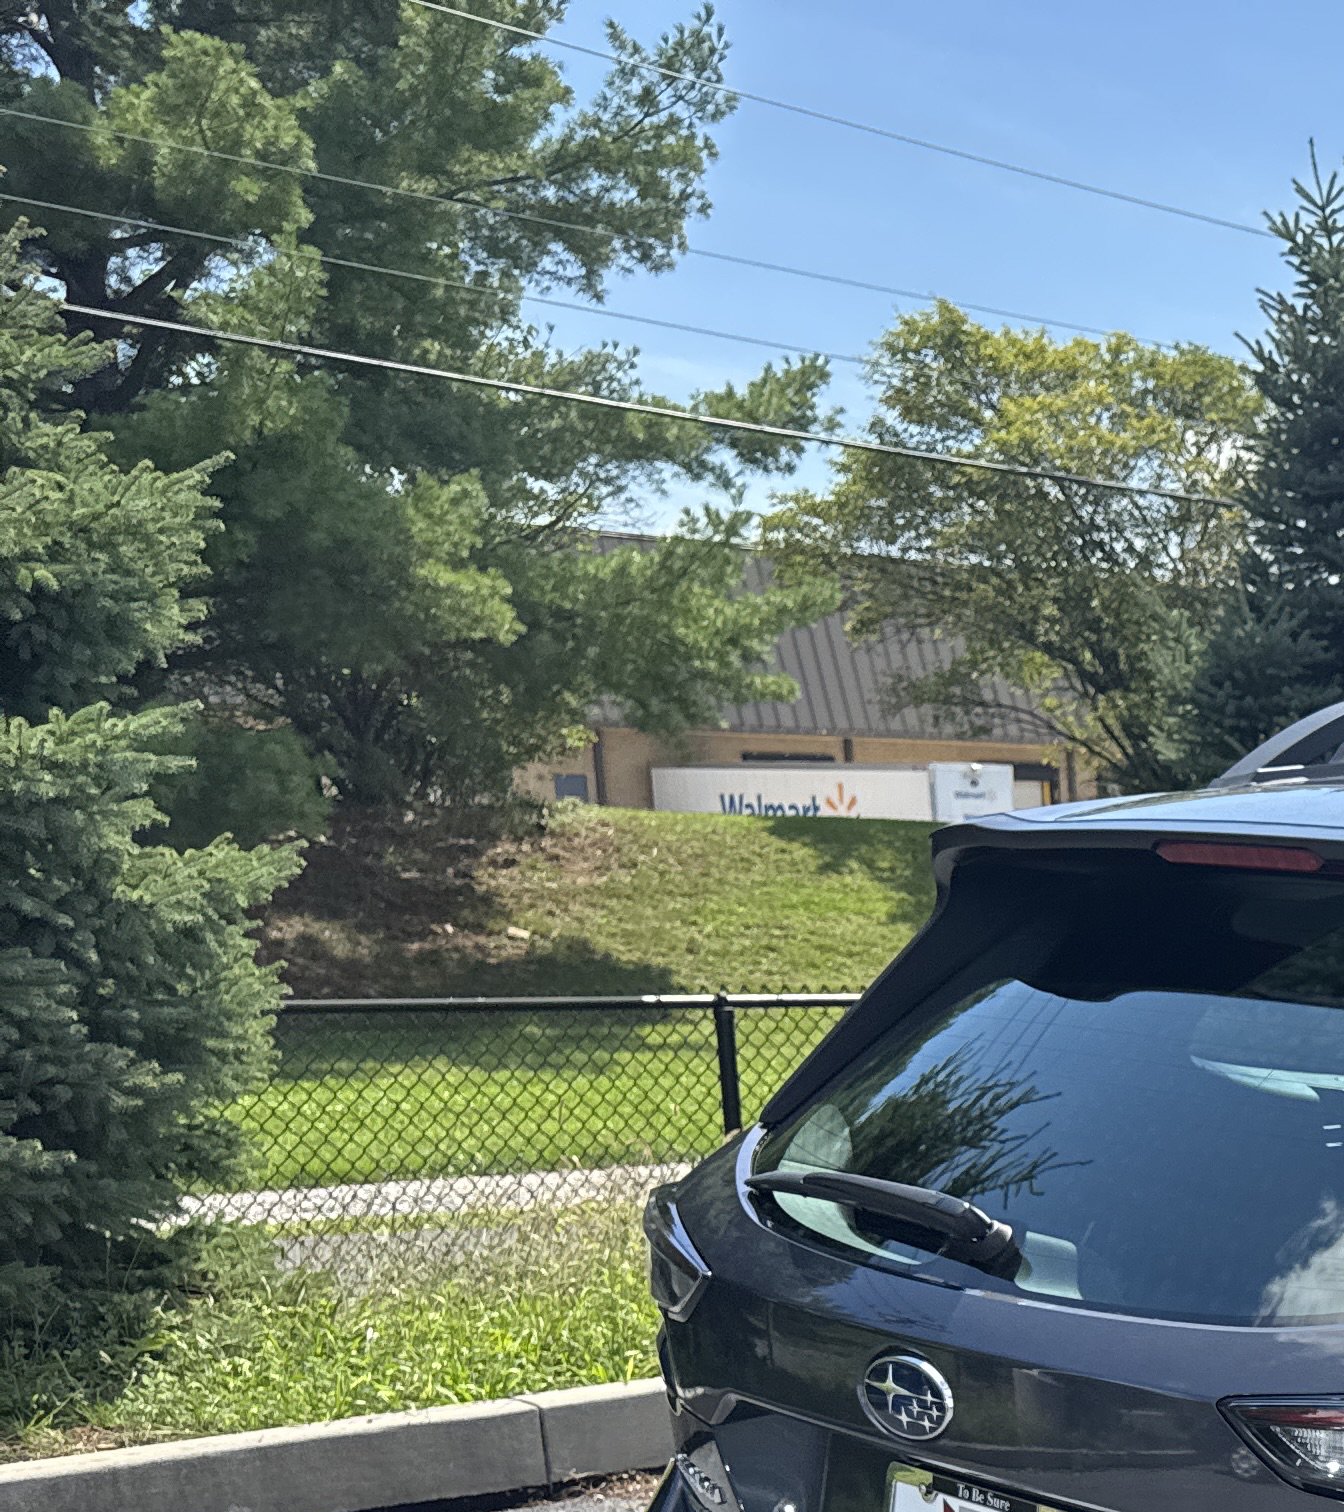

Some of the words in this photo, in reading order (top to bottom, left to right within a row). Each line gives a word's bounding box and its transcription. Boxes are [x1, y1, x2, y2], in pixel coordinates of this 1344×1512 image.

[719, 793, 822, 817] Walmart
[956, 1483, 970, 1499] To
[972, 1487, 986, 1503] Be
[986, 1491, 1011, 1512] Sure
